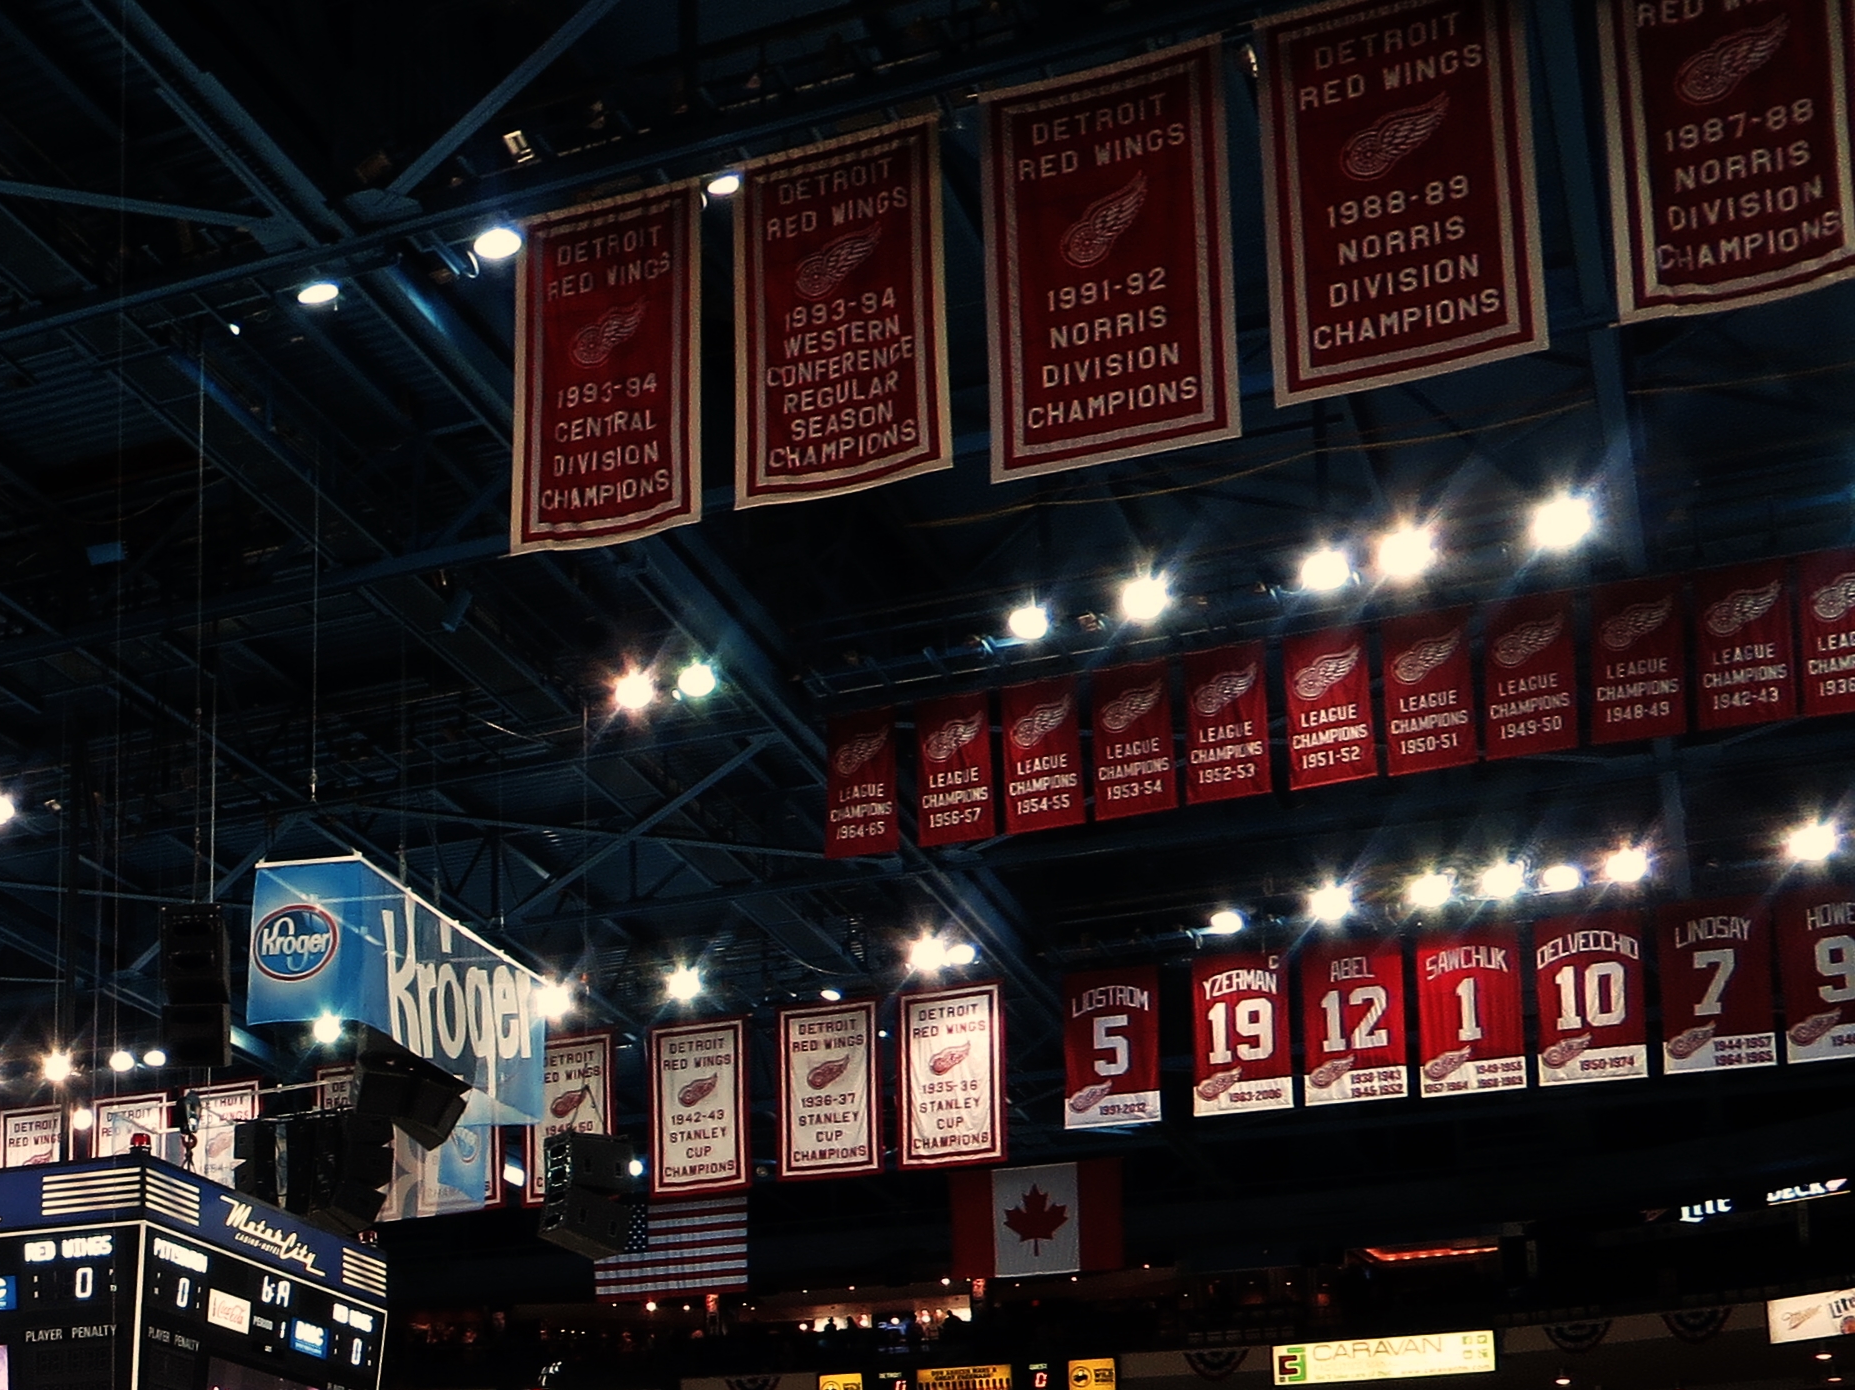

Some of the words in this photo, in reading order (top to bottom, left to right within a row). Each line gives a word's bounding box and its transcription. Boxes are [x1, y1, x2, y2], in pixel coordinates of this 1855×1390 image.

[1314, 14, 1461, 70] DETROIT
[1299, 72, 1367, 111] RED
[1383, 43, 1484, 89] WINGS
[1033, 93, 1166, 146] DETROIT
[1664, 98, 1815, 152] 1987-88
[1018, 150, 1079, 180] RED
[1095, 123, 1185, 167] WINGS
[1674, 140, 1811, 193] NORRIS
[778, 157, 892, 204] DETROIT
[766, 213, 818, 241] RED
[832, 186, 909, 225] WINGS
[1327, 175, 1471, 229] 1988-89
[1667, 175, 1823, 230] DIVISION
[1336, 216, 1467, 265] NORRIS
[1656, 210, 1843, 270] CHAMPIONS
[1048, 266, 1167, 311] 1991-92
[1328, 254, 1481, 308] DIVISION
[784, 288, 896, 332] 1993-94
[1051, 305, 1167, 349] NORRIS
[1312, 288, 1501, 351] CHAMPIONS
[784, 314, 900, 359] WESTERN
[766, 336, 915, 388] CONFERENCE
[1043, 342, 1181, 388] DIVISION
[783, 372, 899, 414] REGULAR
[1028, 375, 1199, 430] CHAMPIONS
[791, 401, 894, 441] SEASON
[769, 419, 916, 469] CHAMPIONS
[1399, 688, 1458, 713] LEAGUE
[1605, 701, 1671, 723] 1948-49
[1390, 710, 1469, 735] CHAMPIONS
[1499, 715, 1563, 740] 1949-50
[1399, 733, 1459, 755] 1950-51
[929, 767, 979, 788] LEAGUE
[1017, 753, 1068, 775] LEAGUE
[922, 787, 989, 809] CHAMPIONS
[1009, 773, 1078, 796] CHAMPIONS
[929, 807, 982, 828] 1956-57
[1017, 794, 1071, 816] 1954-55
[262, 916, 331, 972] Kroger
[1537, 930, 1639, 969] DELVECCHIO
[1675, 916, 1751, 948] LINDSAY
[1330, 956, 1375, 982] ABEL
[1426, 946, 1509, 980] SAWCHUK
[1693, 949, 1735, 1016] 7
[382, 895, 531, 1097] Kroger
[1202, 969, 1278, 1000] YZERMAN
[1555, 961, 1625, 1030] 10
[913, 1021, 939, 1038] RED
[945, 1019, 986, 1033] WINGS
[918, 1004, 978, 1021] DETROIT
[1321, 986, 1389, 1053] 12
[1456, 978, 1482, 1041] 1
[669, 1038, 725, 1054] DETROIT
[1093, 1014, 1129, 1077] 5
[1208, 997, 1273, 1065] 19
[663, 1055, 689, 1071] RED
[694, 1052, 731, 1067] WINGS
[919, 1098, 980, 1114] STANLEY
[922, 1079, 978, 1094] 1935-36
[670, 1109, 725, 1125] 1942-43
[670, 1127, 727, 1143] STANLEY
[936, 1116, 964, 1130] CUP
[686, 1145, 712, 1159] CUP
[913, 1132, 990, 1151] CHAMPIONS
[664, 1160, 735, 1178] CHAMPIONS
[24, 1241, 56, 1261] RED
[62, 1235, 113, 1258] WINGS
[76, 1267, 92, 1298] 0
[25, 1328, 62, 1343] PLAYER
[72, 1324, 116, 1339] PENALTY
[1313, 1337, 1443, 1361] CARAVAN
